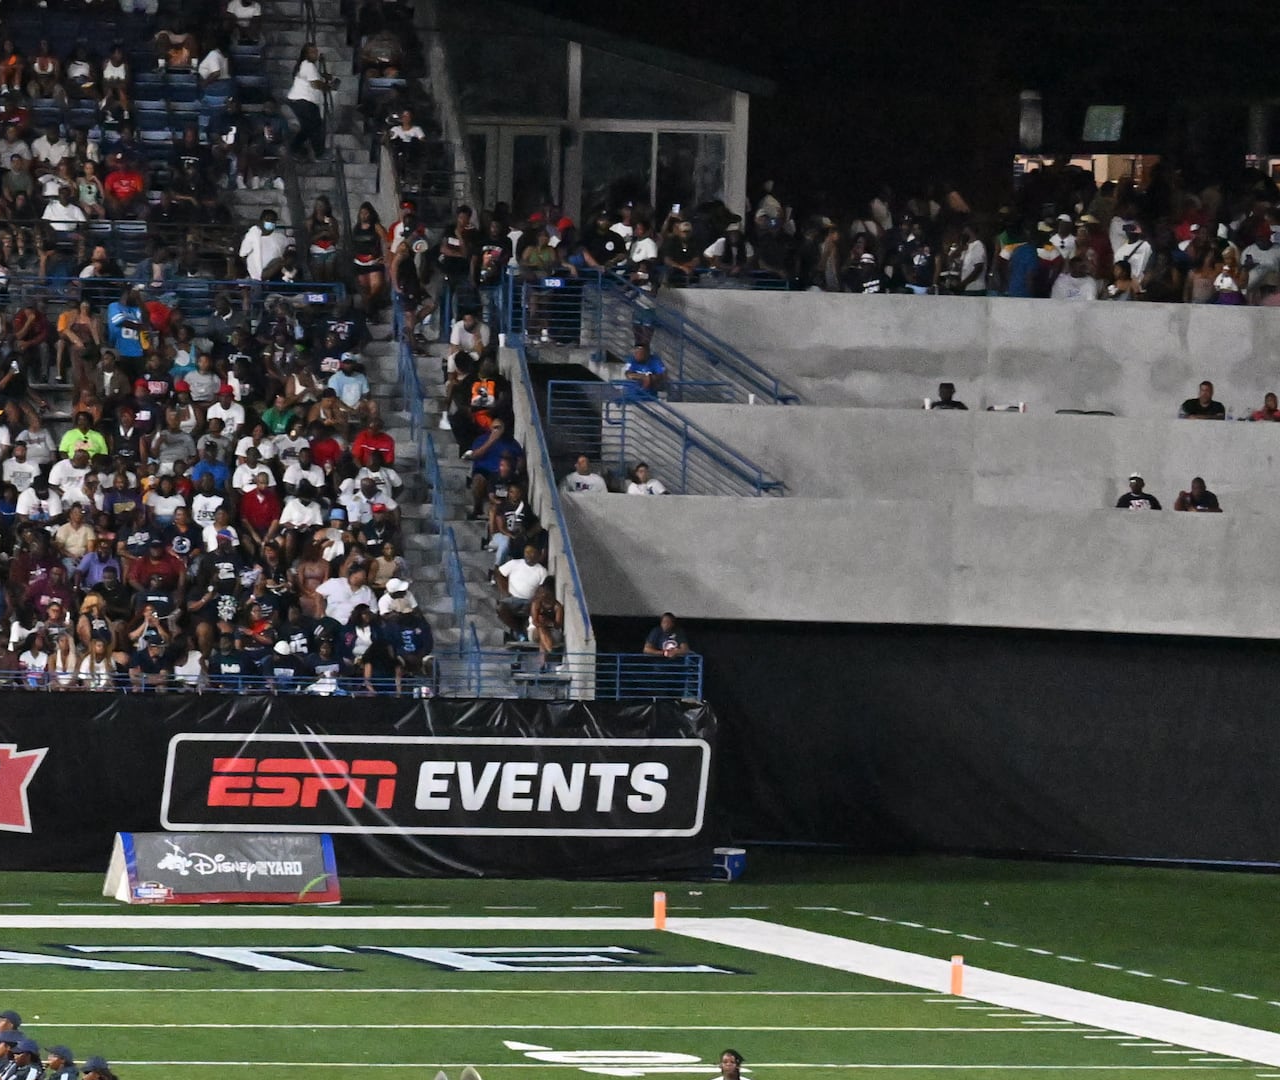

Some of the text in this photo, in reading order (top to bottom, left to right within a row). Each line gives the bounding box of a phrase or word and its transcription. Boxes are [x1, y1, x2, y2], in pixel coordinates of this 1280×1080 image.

[206, 757, 670, 814] ESPN EVENTS
[188, 852, 257, 881] Disney
[267, 860, 303, 876] YARD
